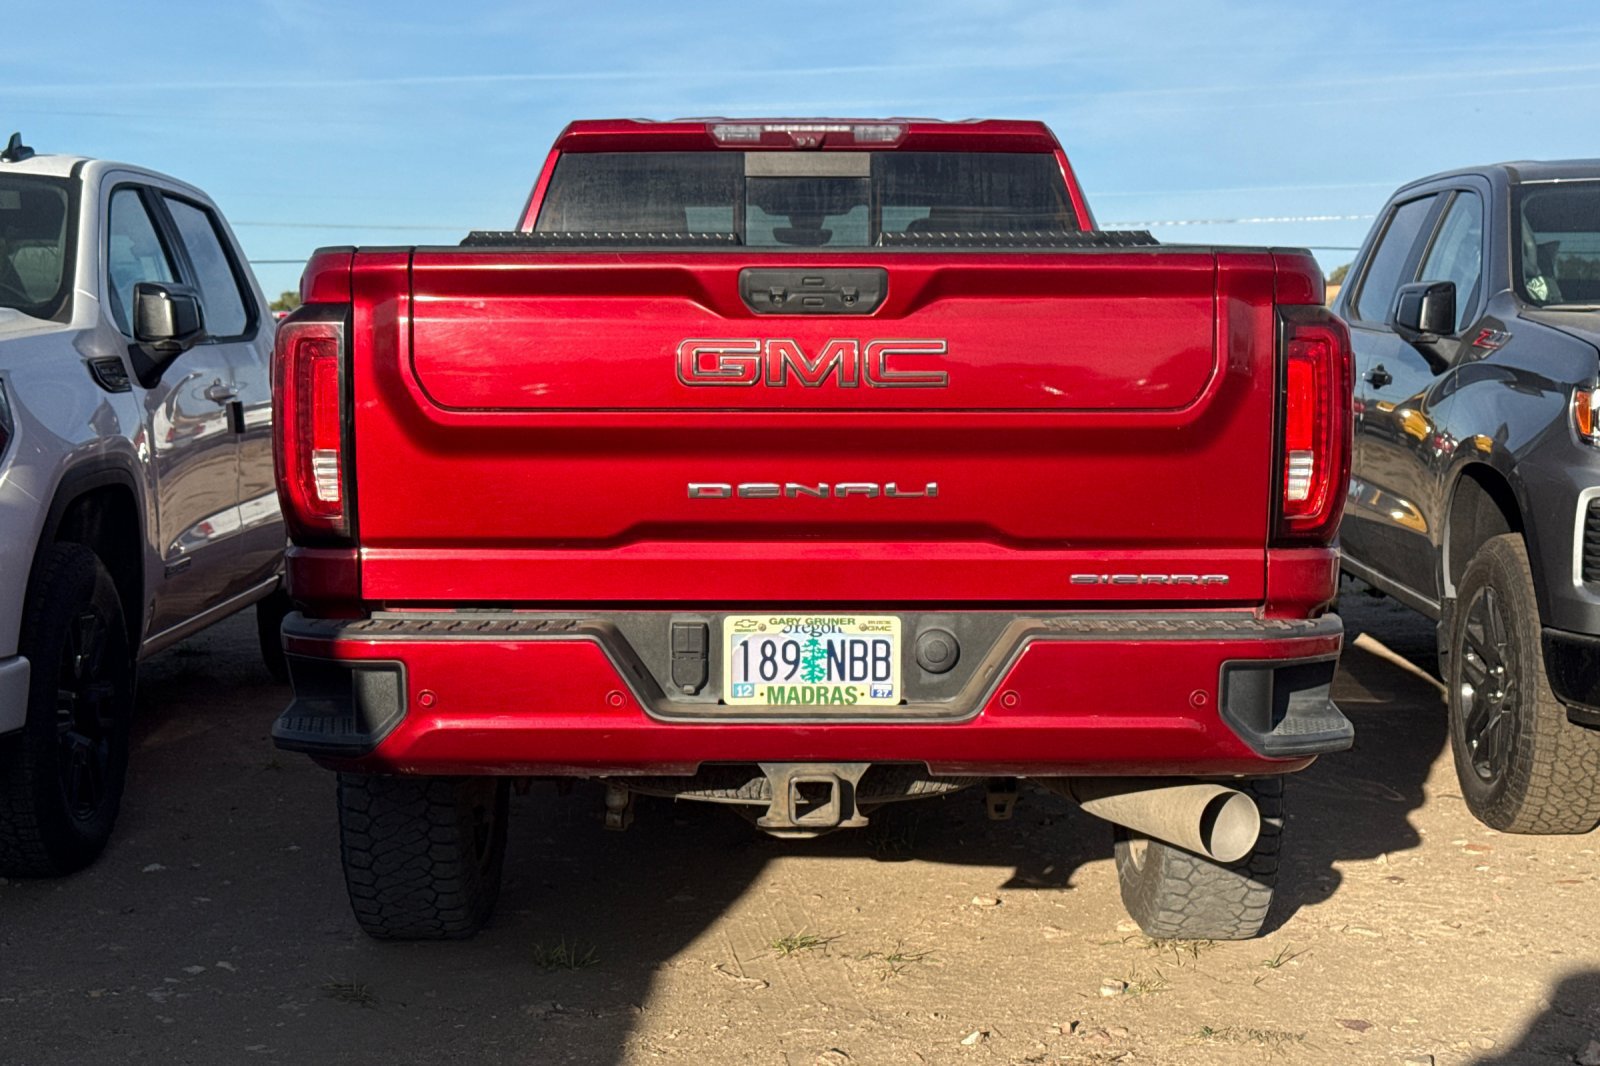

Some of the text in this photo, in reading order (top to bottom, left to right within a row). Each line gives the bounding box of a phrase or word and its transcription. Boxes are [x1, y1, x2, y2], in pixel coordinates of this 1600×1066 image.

[676, 338, 949, 388] GMC
[688, 482, 938, 498] DENALI
[1070, 574, 1229, 584] SIERRA
[768, 617, 856, 625] GARY GRUNER
[740, 639, 891, 682] 189 NBB
[736, 686, 753, 696] 12
[767, 686, 858, 704] MADRAS
[876, 688, 890, 698] 27
